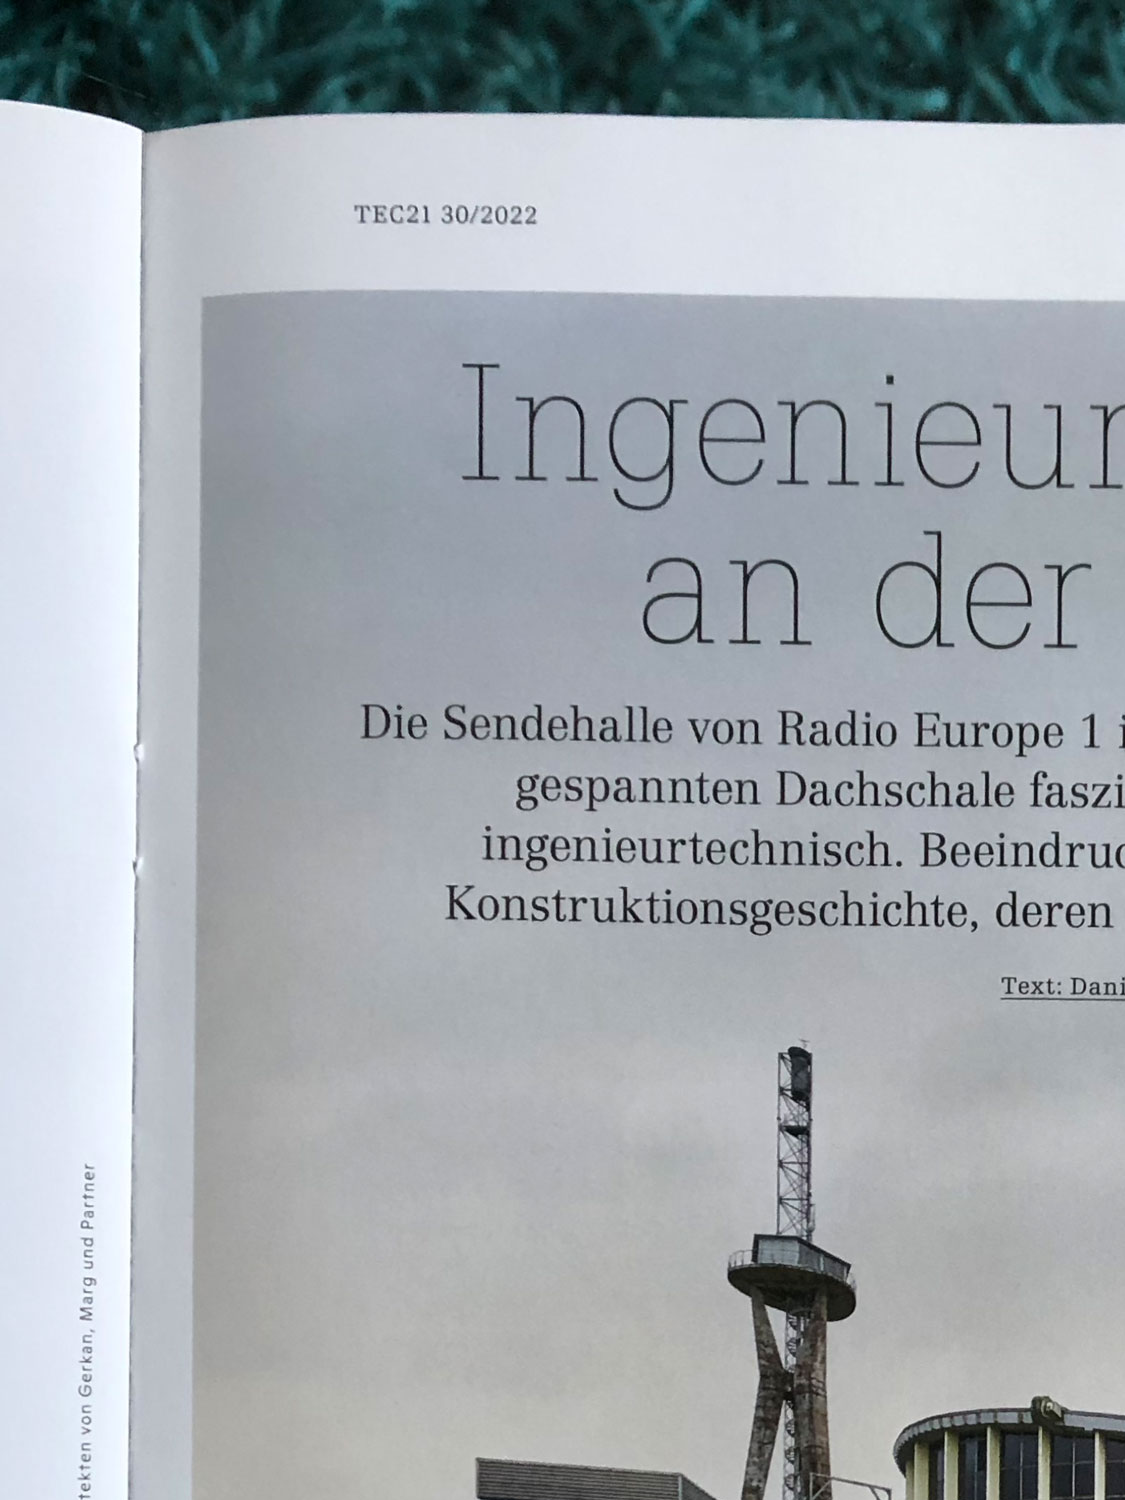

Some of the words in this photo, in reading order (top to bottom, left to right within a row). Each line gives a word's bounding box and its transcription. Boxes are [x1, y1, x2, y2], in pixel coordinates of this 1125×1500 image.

[353, 204, 431, 225] TEC21
[440, 204, 538, 226] 30/2022
[642, 557, 813, 646] an
[875, 530, 1092, 650] der
[361, 703, 428, 740] Die
[443, 703, 673, 744] Sendehalle
[687, 718, 763, 745] von
[777, 709, 898, 748] Radio
[914, 711, 1064, 758] Europe
[1082, 713, 1101, 749] 1
[515, 772, 761, 812] gespannten
[776, 769, 1015, 808] Dachschale
[482, 825, 903, 872] ingenieurtechnisch.
[445, 884, 978, 937] Konstruktionsgeschichte,
[995, 890, 1114, 929] deren
[1000, 976, 1062, 996] Text:
[79, 1163, 96, 1230] Partner
[79, 1236, 95, 1270] und
[78, 1276, 98, 1322] Marg
[77, 1328, 96, 1398] Gerkan,
[80, 1404, 93, 1436] von
